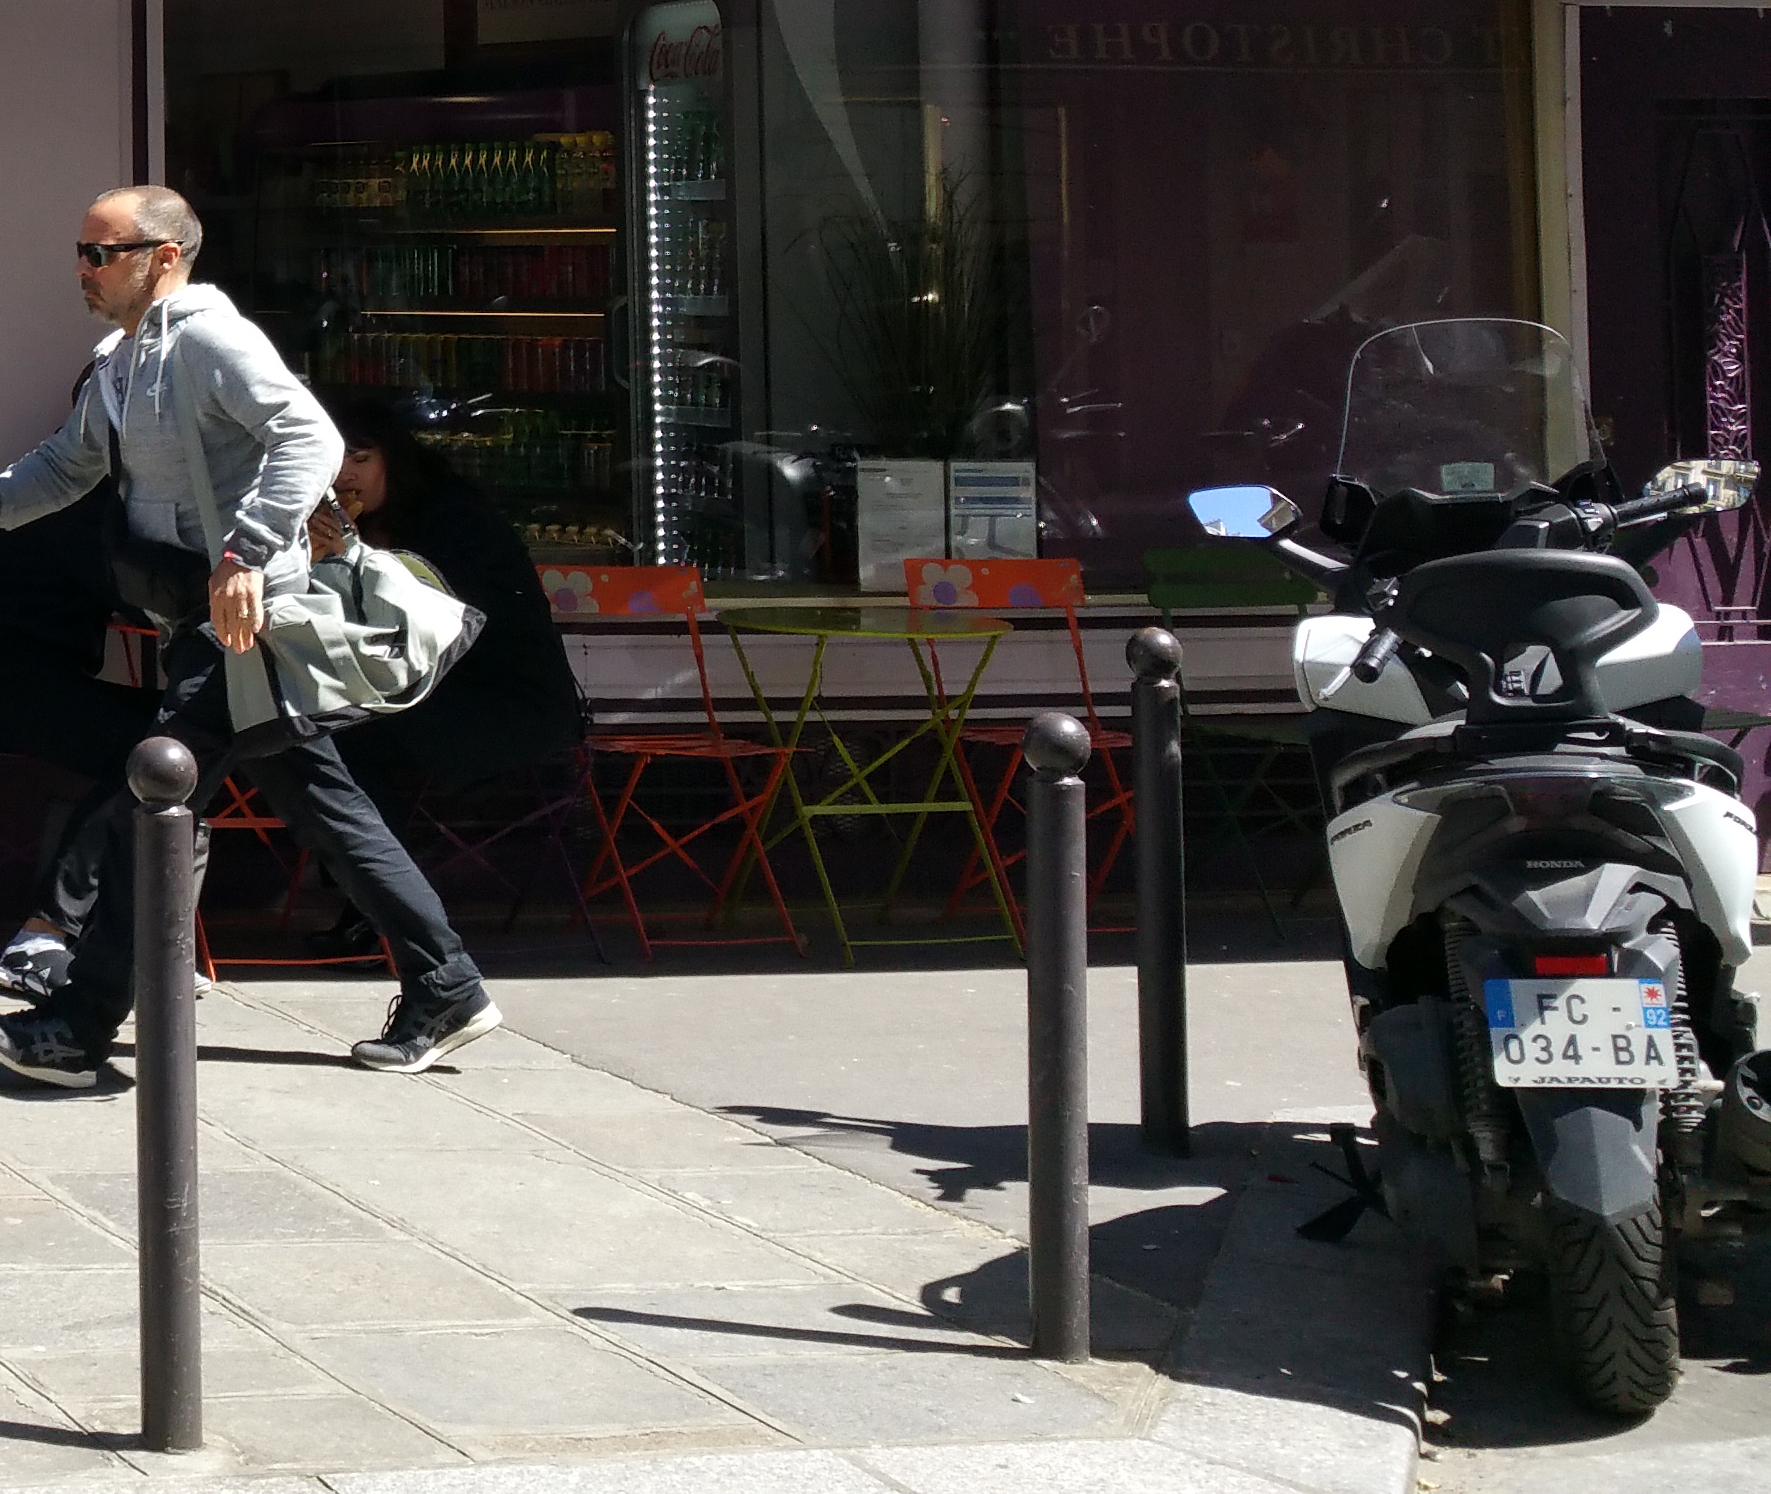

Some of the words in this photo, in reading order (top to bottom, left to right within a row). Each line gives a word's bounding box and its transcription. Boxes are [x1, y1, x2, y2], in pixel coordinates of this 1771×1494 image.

[1526, 860, 1585, 869] HONDA
[1536, 993, 1589, 1026] FC
[1646, 1009, 1669, 1026] 92
[1531, 1075, 1648, 1086] JAPAUTO
